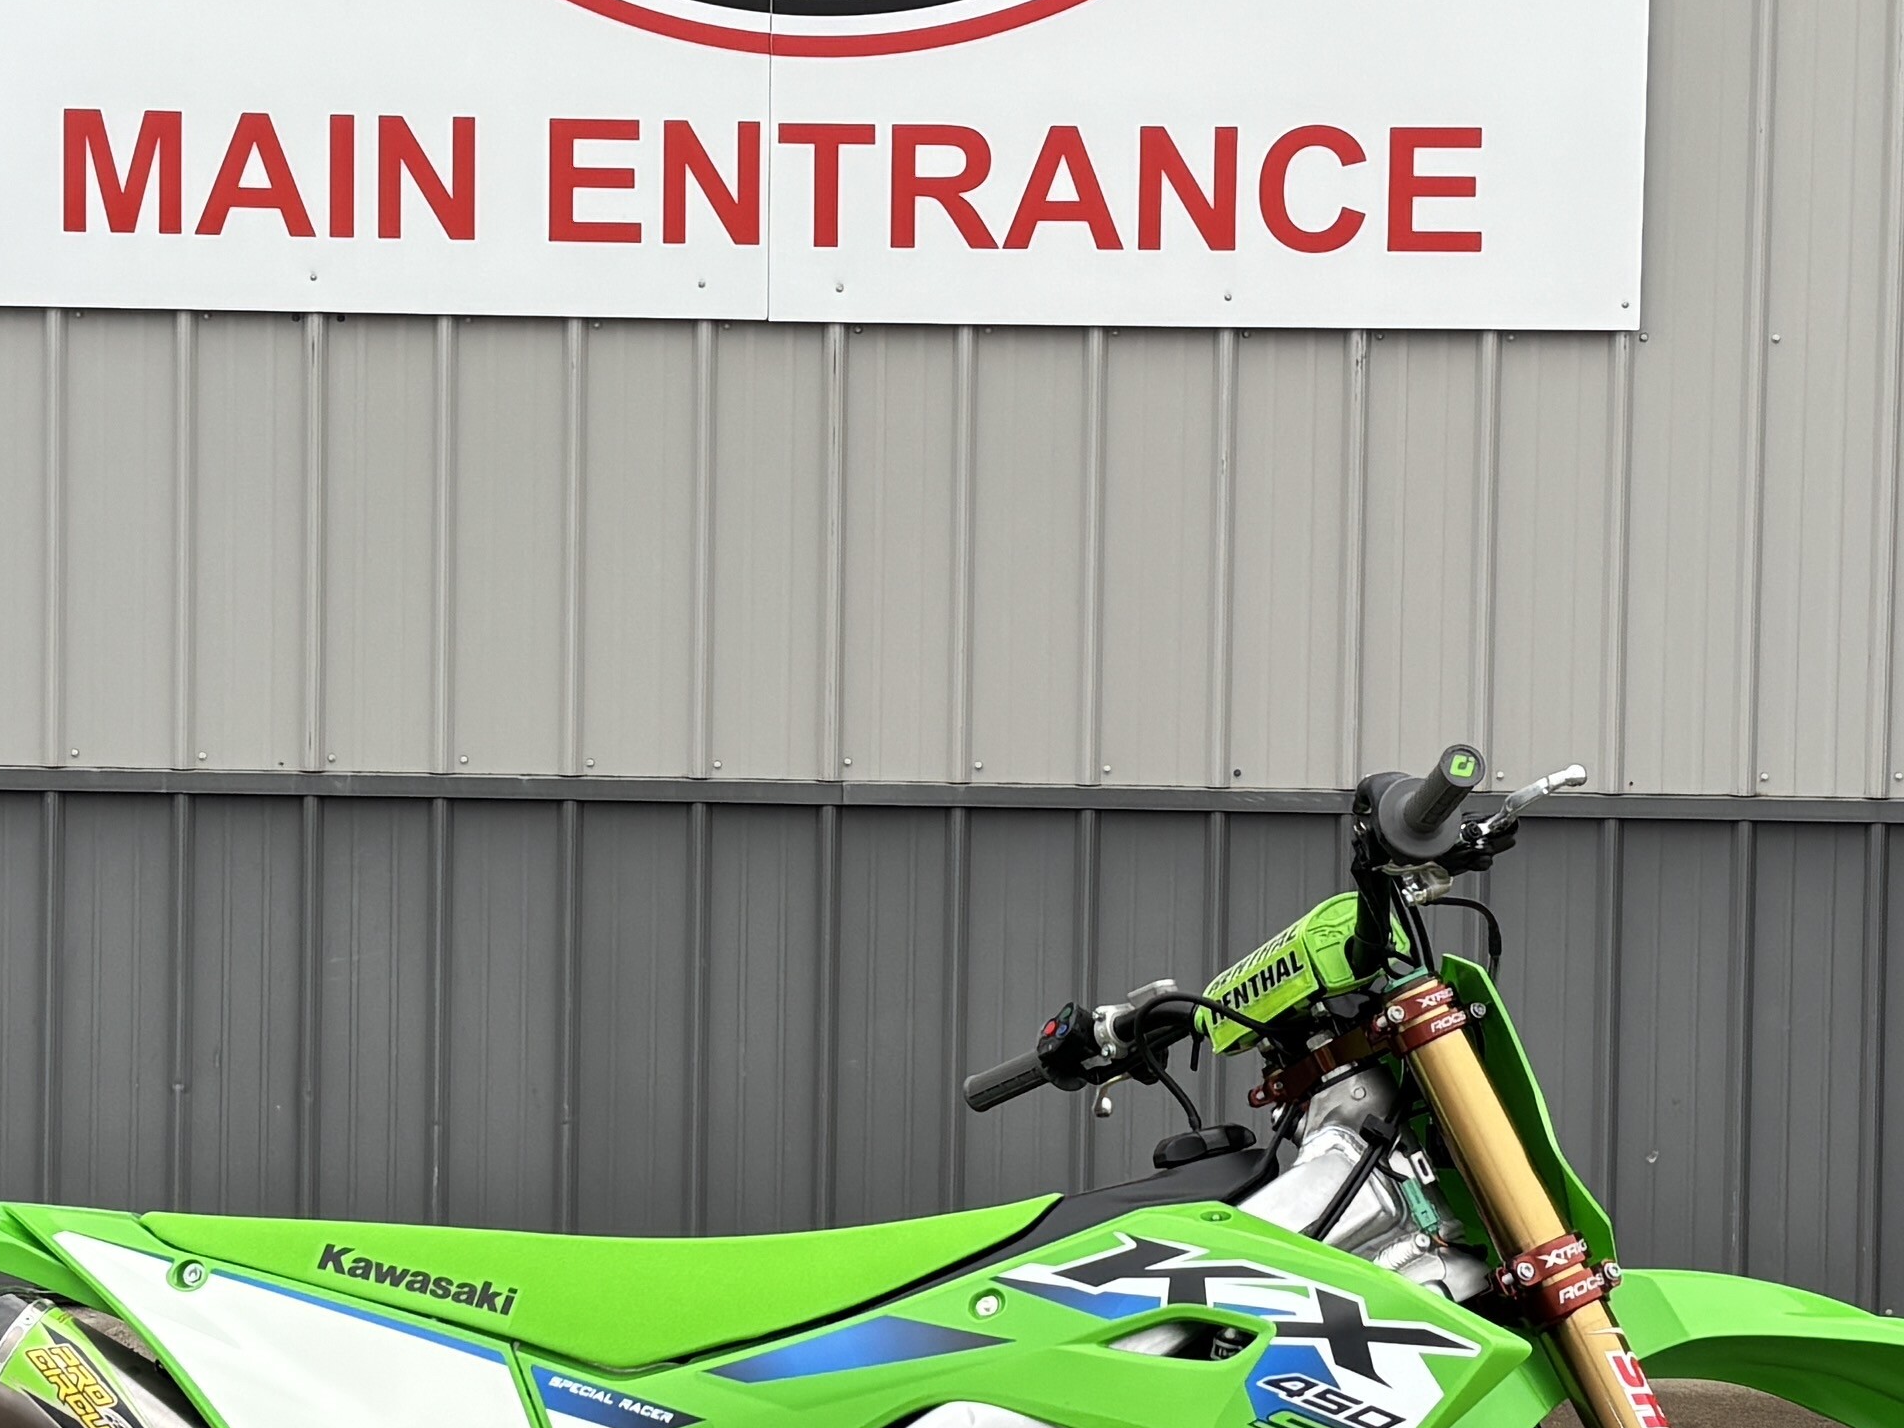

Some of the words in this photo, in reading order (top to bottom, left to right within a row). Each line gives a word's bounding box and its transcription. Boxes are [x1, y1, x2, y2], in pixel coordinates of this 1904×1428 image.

[62, 108, 475, 240] MAIN
[548, 118, 1482, 254] ENTRANCE
[317, 1243, 519, 1317] Kawasaki
[1051, 1236, 1477, 1389] KX
[49, 1344, 116, 1408] PRO
[548, 1375, 614, 1405] SPECIAL
[618, 1398, 674, 1424] RACER
